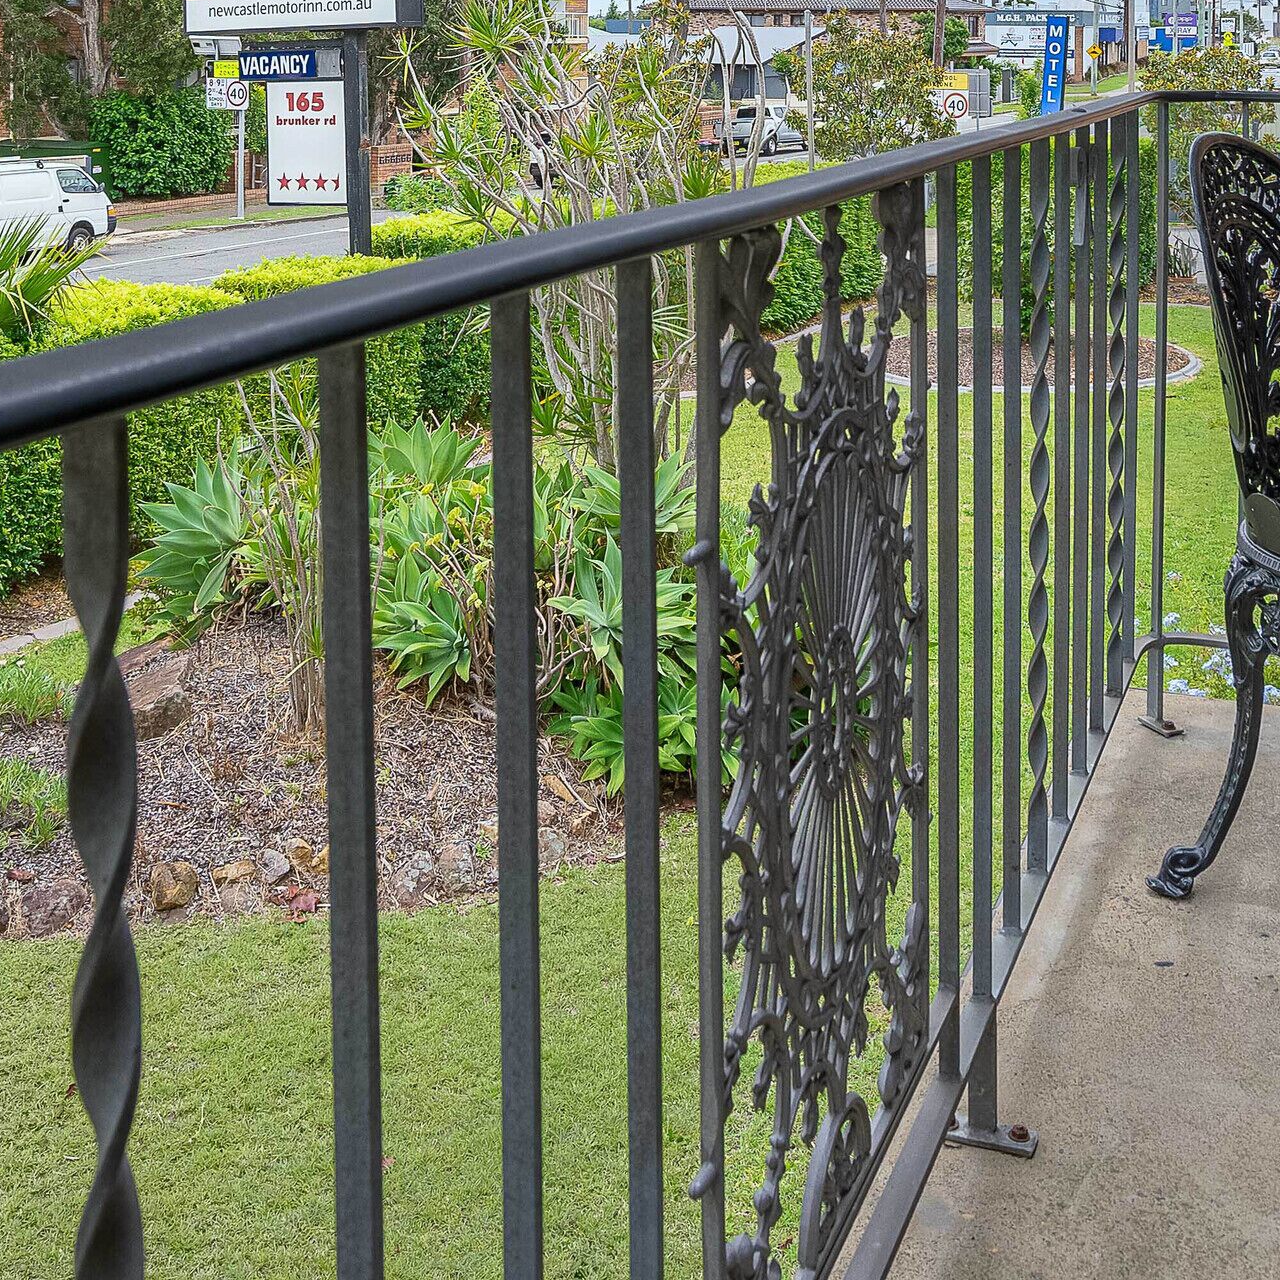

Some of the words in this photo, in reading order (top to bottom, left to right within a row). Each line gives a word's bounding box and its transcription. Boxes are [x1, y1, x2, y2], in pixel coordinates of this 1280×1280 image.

[208, 0, 372, 17] newcastlemotorinn.com.au
[1026, 14, 1075, 22] PACKG
[240, 54, 310, 76] VACANCY
[1047, 25, 1063, 103] MOTEL
[230, 88, 244, 99] 40
[286, 92, 324, 112] 165
[948, 100, 964, 111] 40
[276, 115, 320, 126] brunker
[324, 115, 336, 126] rd
